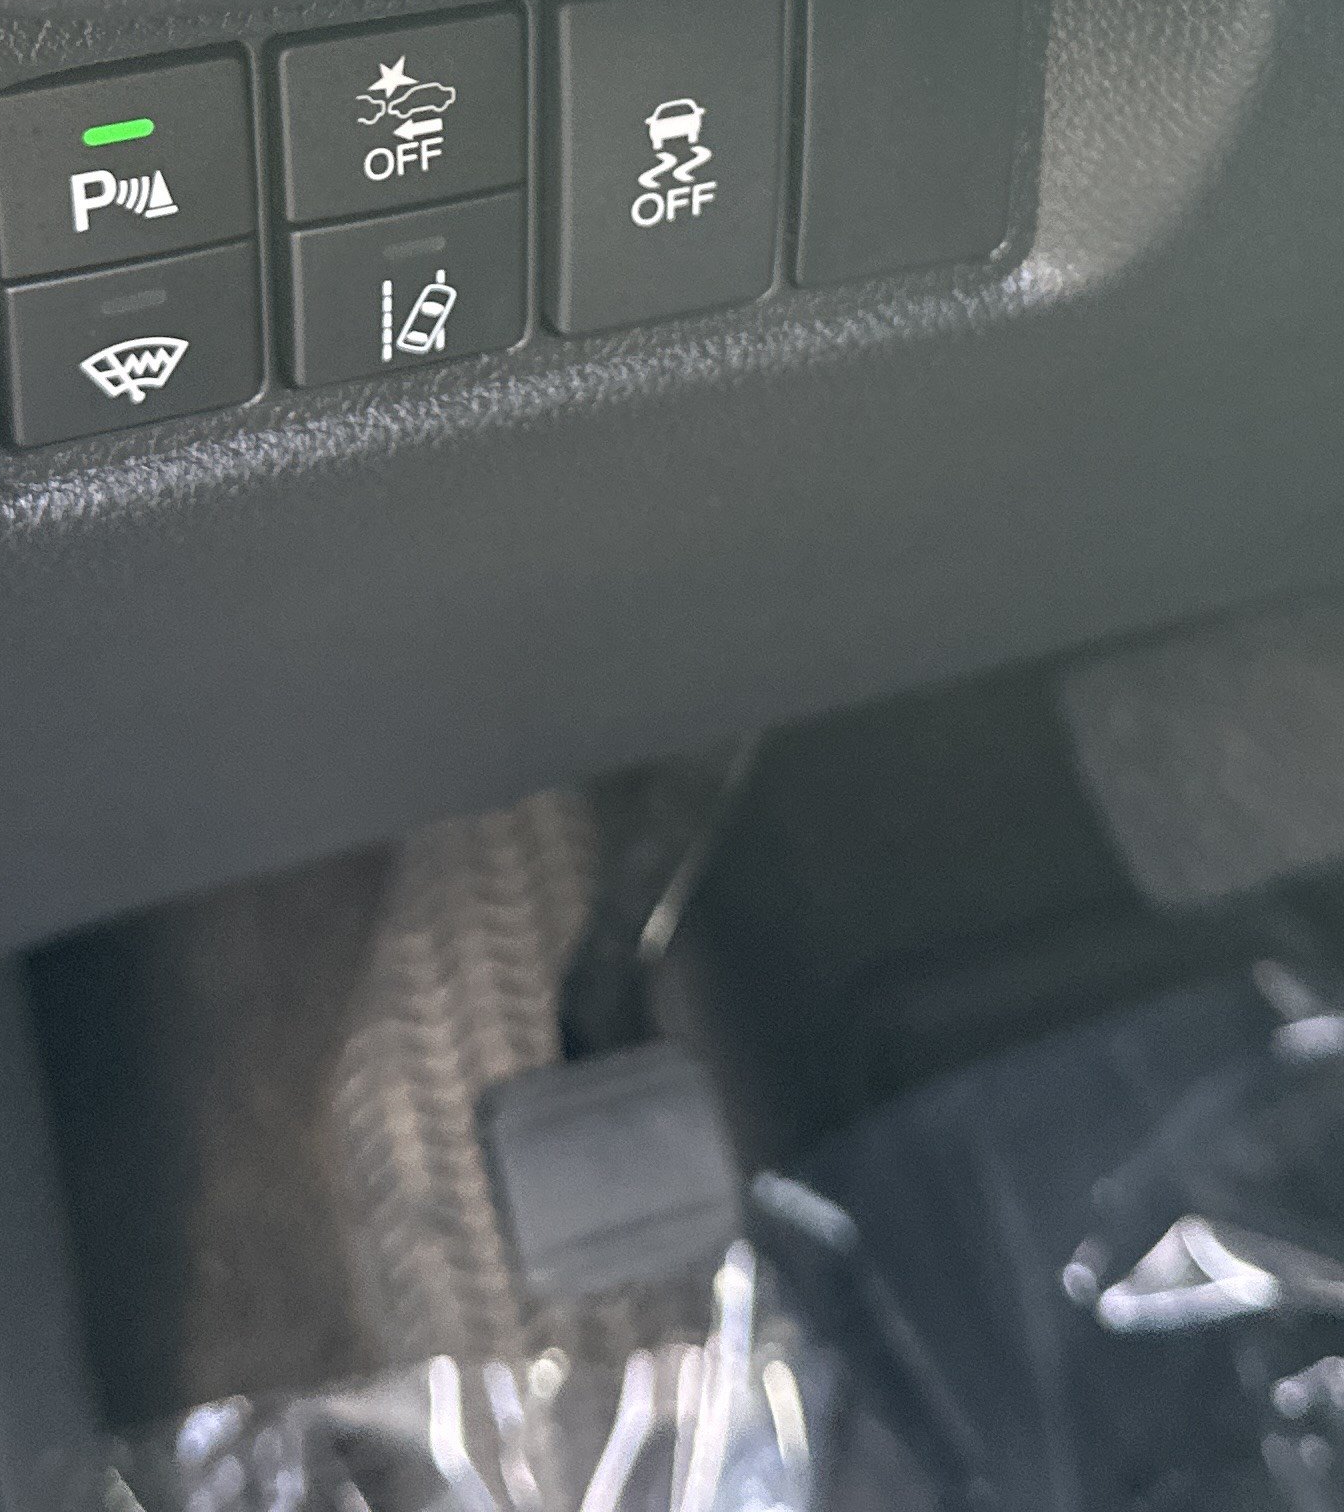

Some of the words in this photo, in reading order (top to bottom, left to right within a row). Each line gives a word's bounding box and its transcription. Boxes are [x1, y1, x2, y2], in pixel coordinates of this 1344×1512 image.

[363, 136, 444, 181] OFF
[70, 170, 112, 233] P
[631, 181, 717, 227] OFF
